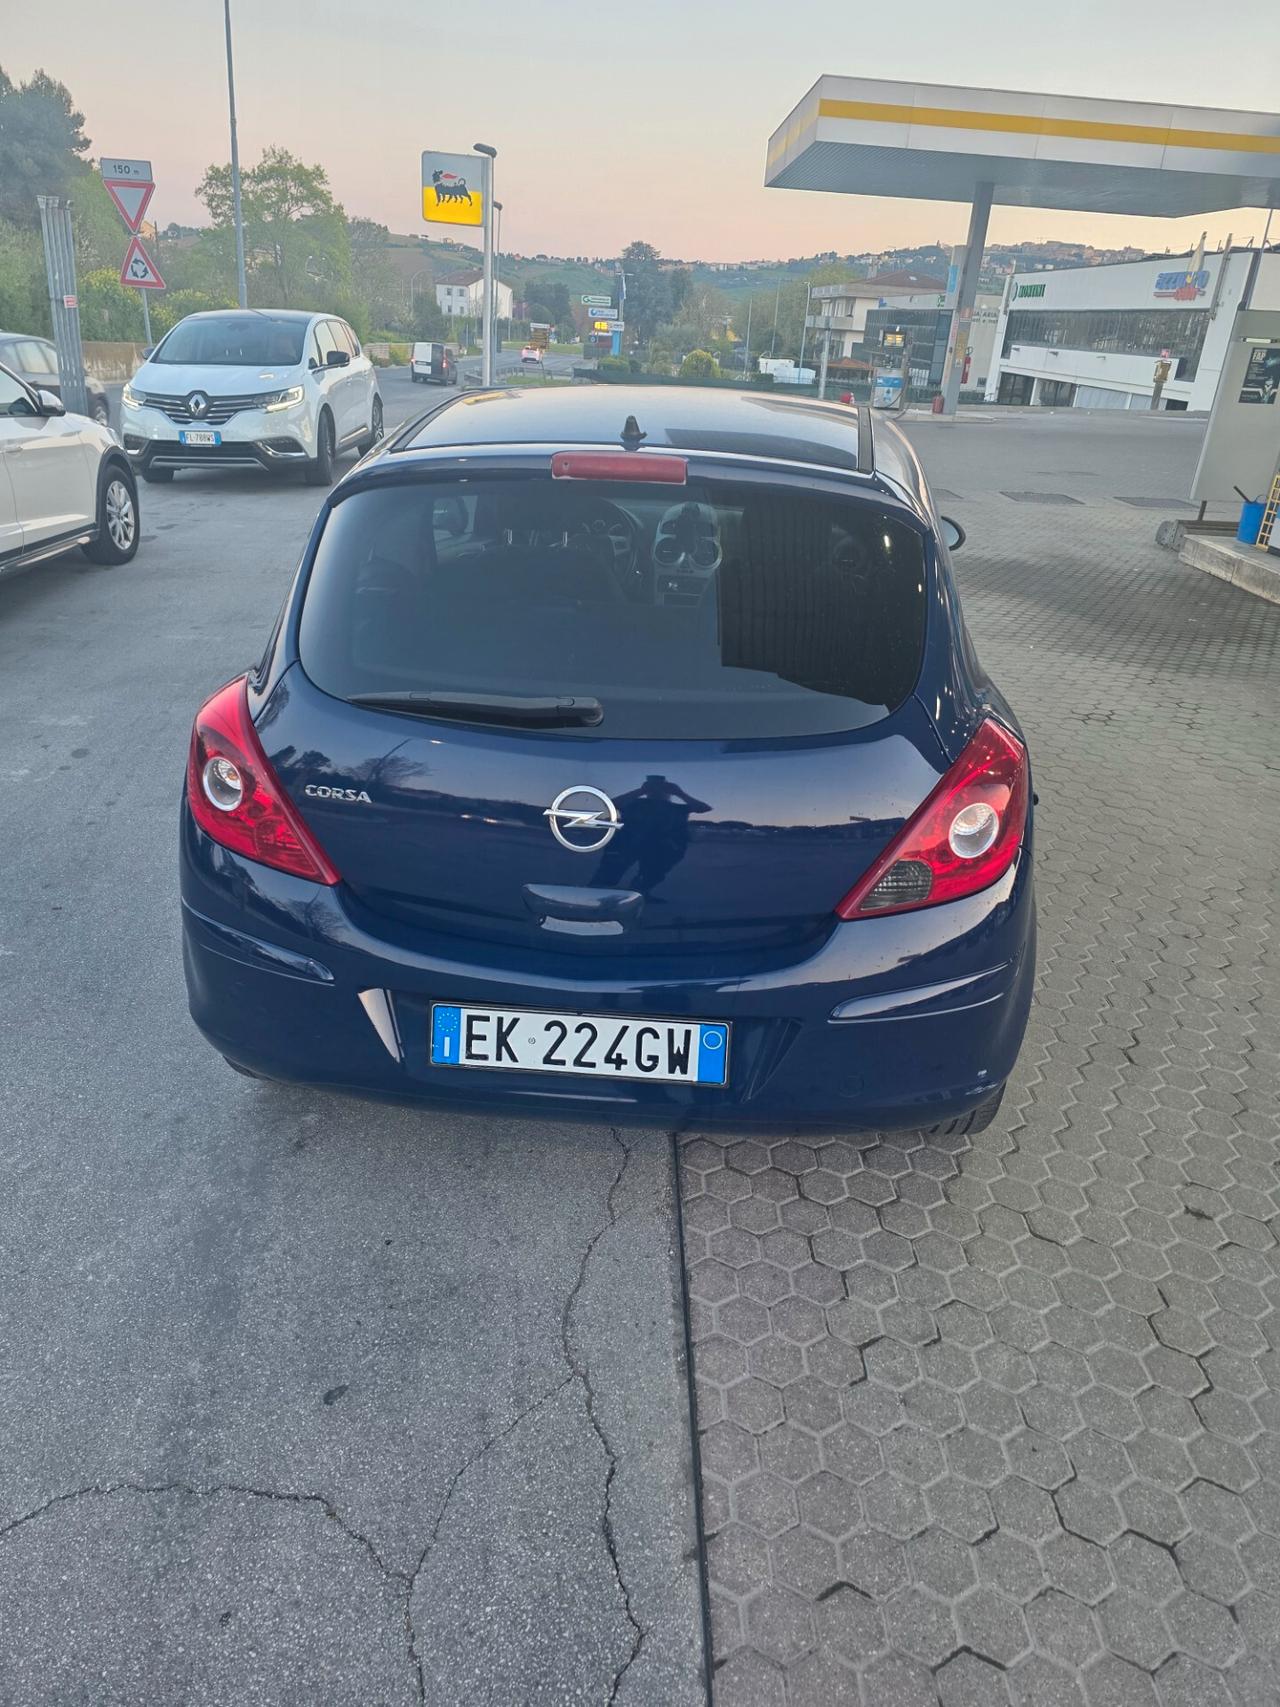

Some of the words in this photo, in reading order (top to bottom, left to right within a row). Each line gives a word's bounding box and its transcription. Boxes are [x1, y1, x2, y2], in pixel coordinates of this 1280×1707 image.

[113, 164, 131, 175] 150
[1252, 351, 1266, 361] FAP
[304, 784, 373, 804] CORSA
[465, 1014, 521, 1064] EK
[542, 1020, 692, 1076] 224GW
